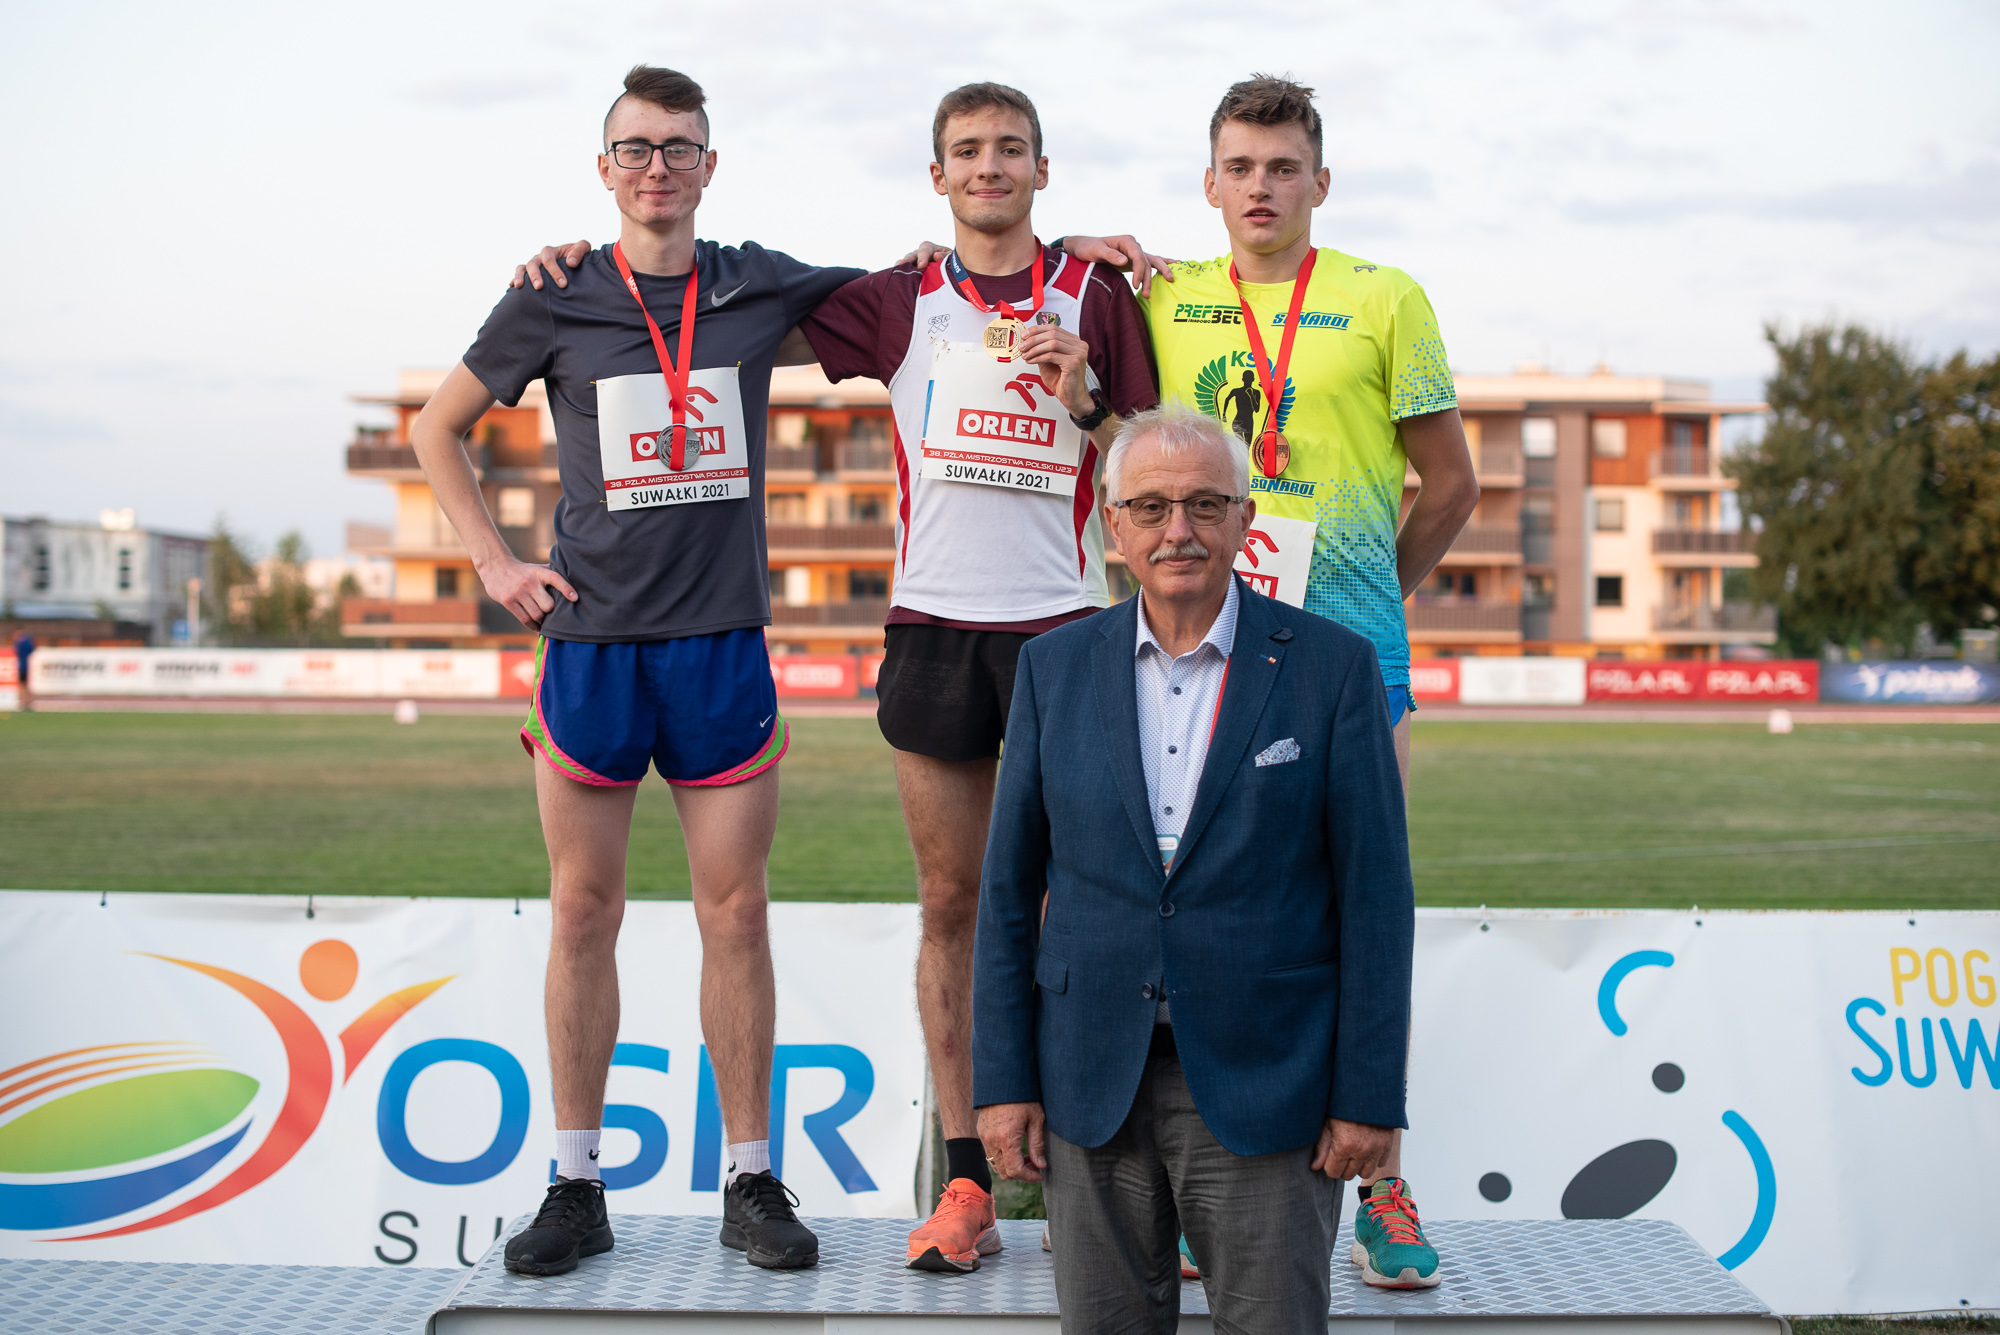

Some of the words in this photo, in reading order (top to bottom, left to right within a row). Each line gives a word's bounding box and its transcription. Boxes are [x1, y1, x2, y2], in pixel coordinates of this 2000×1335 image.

[1272, 311, 1351, 329] SNAROL
[962, 412, 1050, 443] ORLEN
[928, 450, 942, 458] 38.
[943, 451, 965, 460] PZLA
[965, 454, 1025, 466] MISTRZOSTWA
[1025, 461, 1054, 471] POLSKI
[1054, 465, 1073, 474] U23
[610, 480, 624, 488] 38.
[625, 478, 647, 487] PZLA
[647, 473, 706, 484] MISTRZOSTWA
[706, 470, 730, 479] POLSKI
[730, 469, 745, 477] U23
[945, 464, 1012, 484] SUWAŁKI
[1015, 472, 1050, 490] 2021
[631, 486, 698, 505] SUWAŁKI
[701, 483, 730, 498] 2021
[1889, 947, 1997, 1008] POG
[1845, 997, 2000, 1090] SUW
